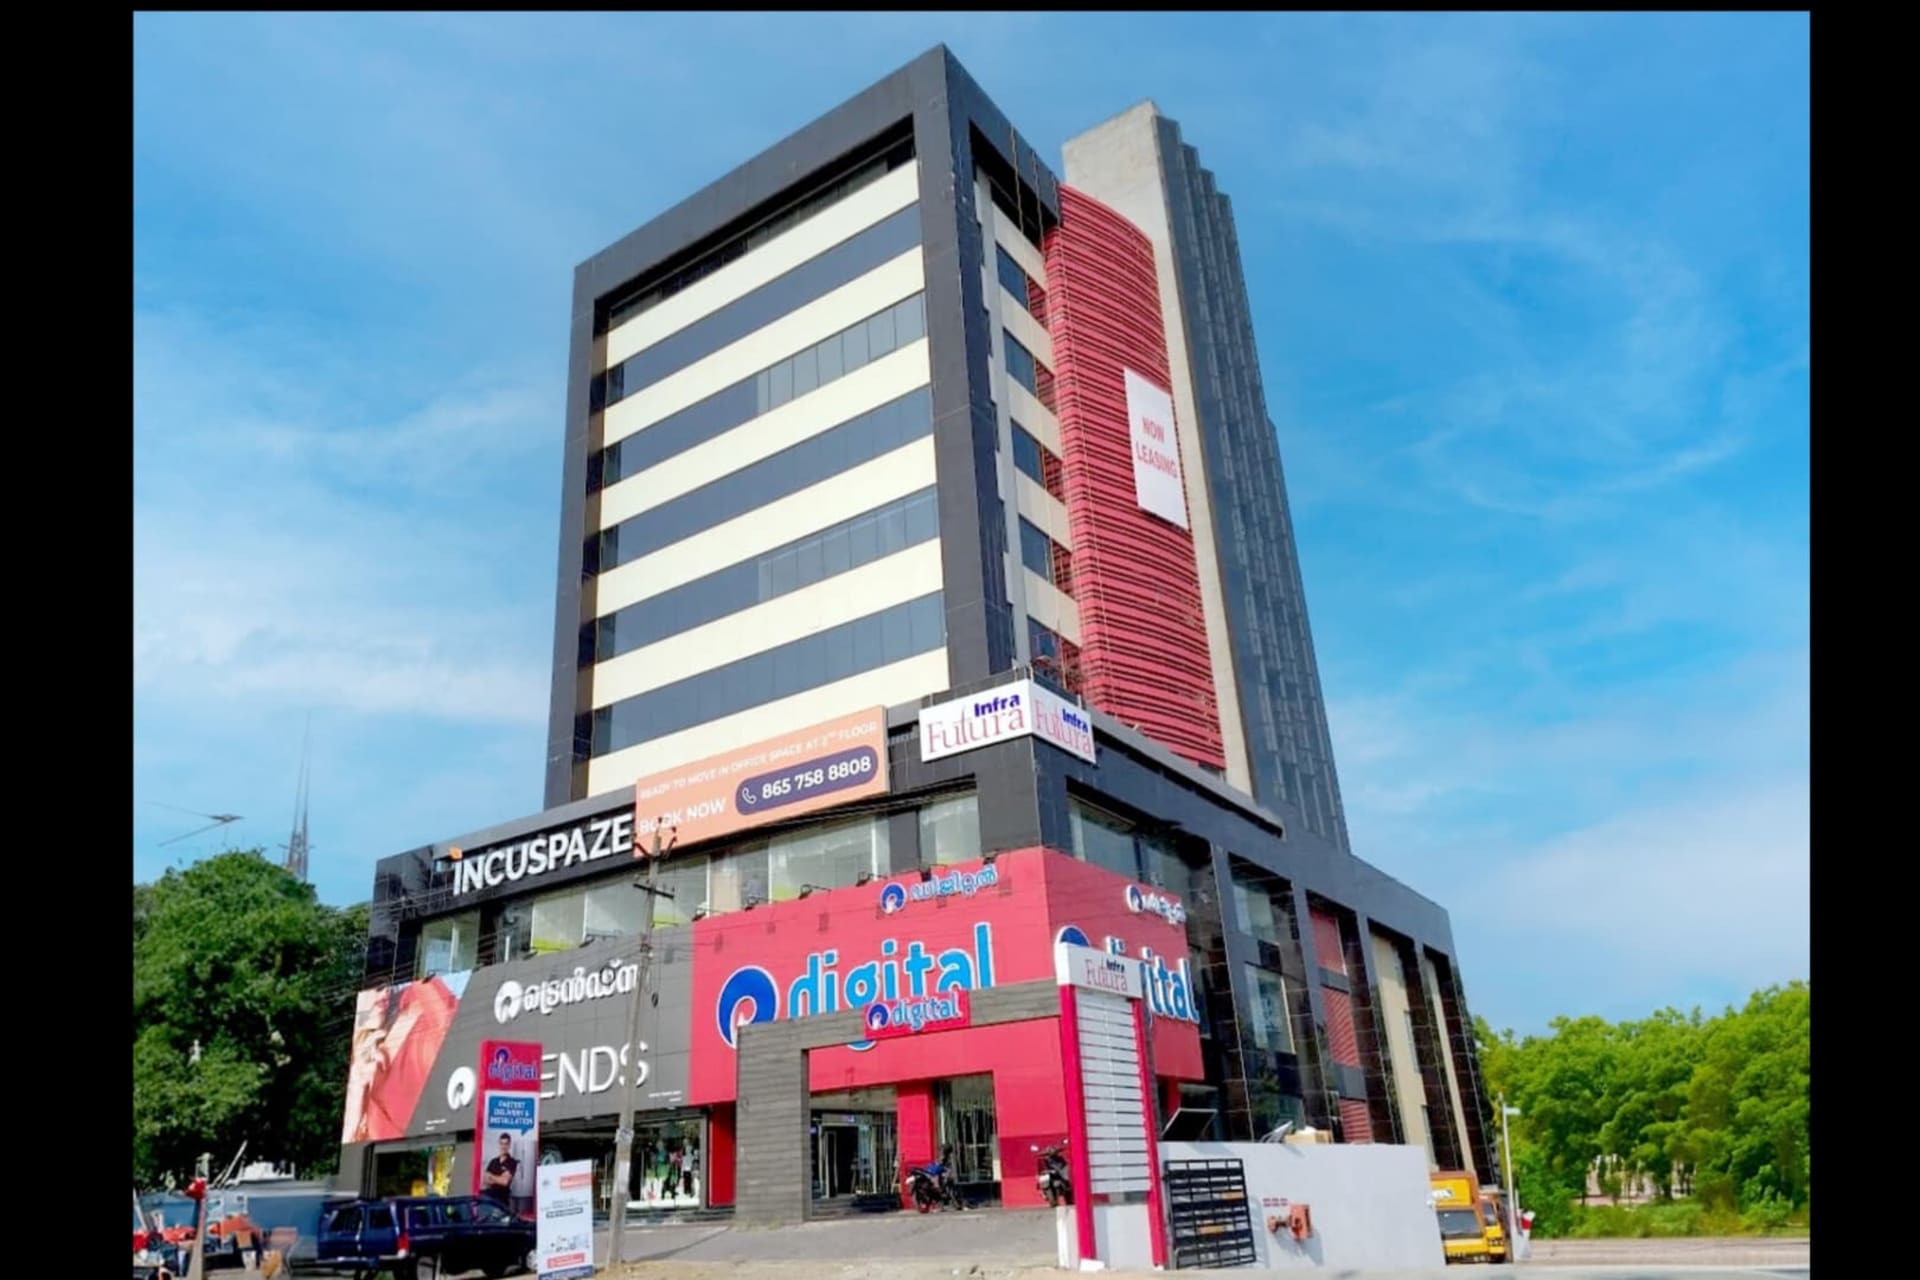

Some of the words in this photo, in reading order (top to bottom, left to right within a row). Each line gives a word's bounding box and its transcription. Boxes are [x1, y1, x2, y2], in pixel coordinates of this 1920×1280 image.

[1142, 416, 1165, 443] NOW
[1136, 441, 1178, 479] LEASING
[974, 693, 1020, 717] Infra
[1062, 707, 1089, 733] Infra
[927, 705, 1025, 754] Futura
[1035, 698, 1093, 754] Futura
[673, 777, 687, 789] TO
[688, 768, 717, 784] MOVE
[718, 765, 730, 775] IN
[768, 742, 802, 762] SPACE
[804, 737, 821, 750] AT
[838, 720, 878, 739] FLOOR
[762, 777, 791, 799] 865
[795, 769, 824, 790] 758
[828, 756, 871, 781] 8808
[686, 798, 726, 820] NOW
[453, 814, 633, 896] INCUSPAZE
[786, 921, 997, 1050] digital
[1084, 957, 1129, 993] Futura
[890, 991, 961, 1032] digital
[488, 1058, 538, 1085] digital
